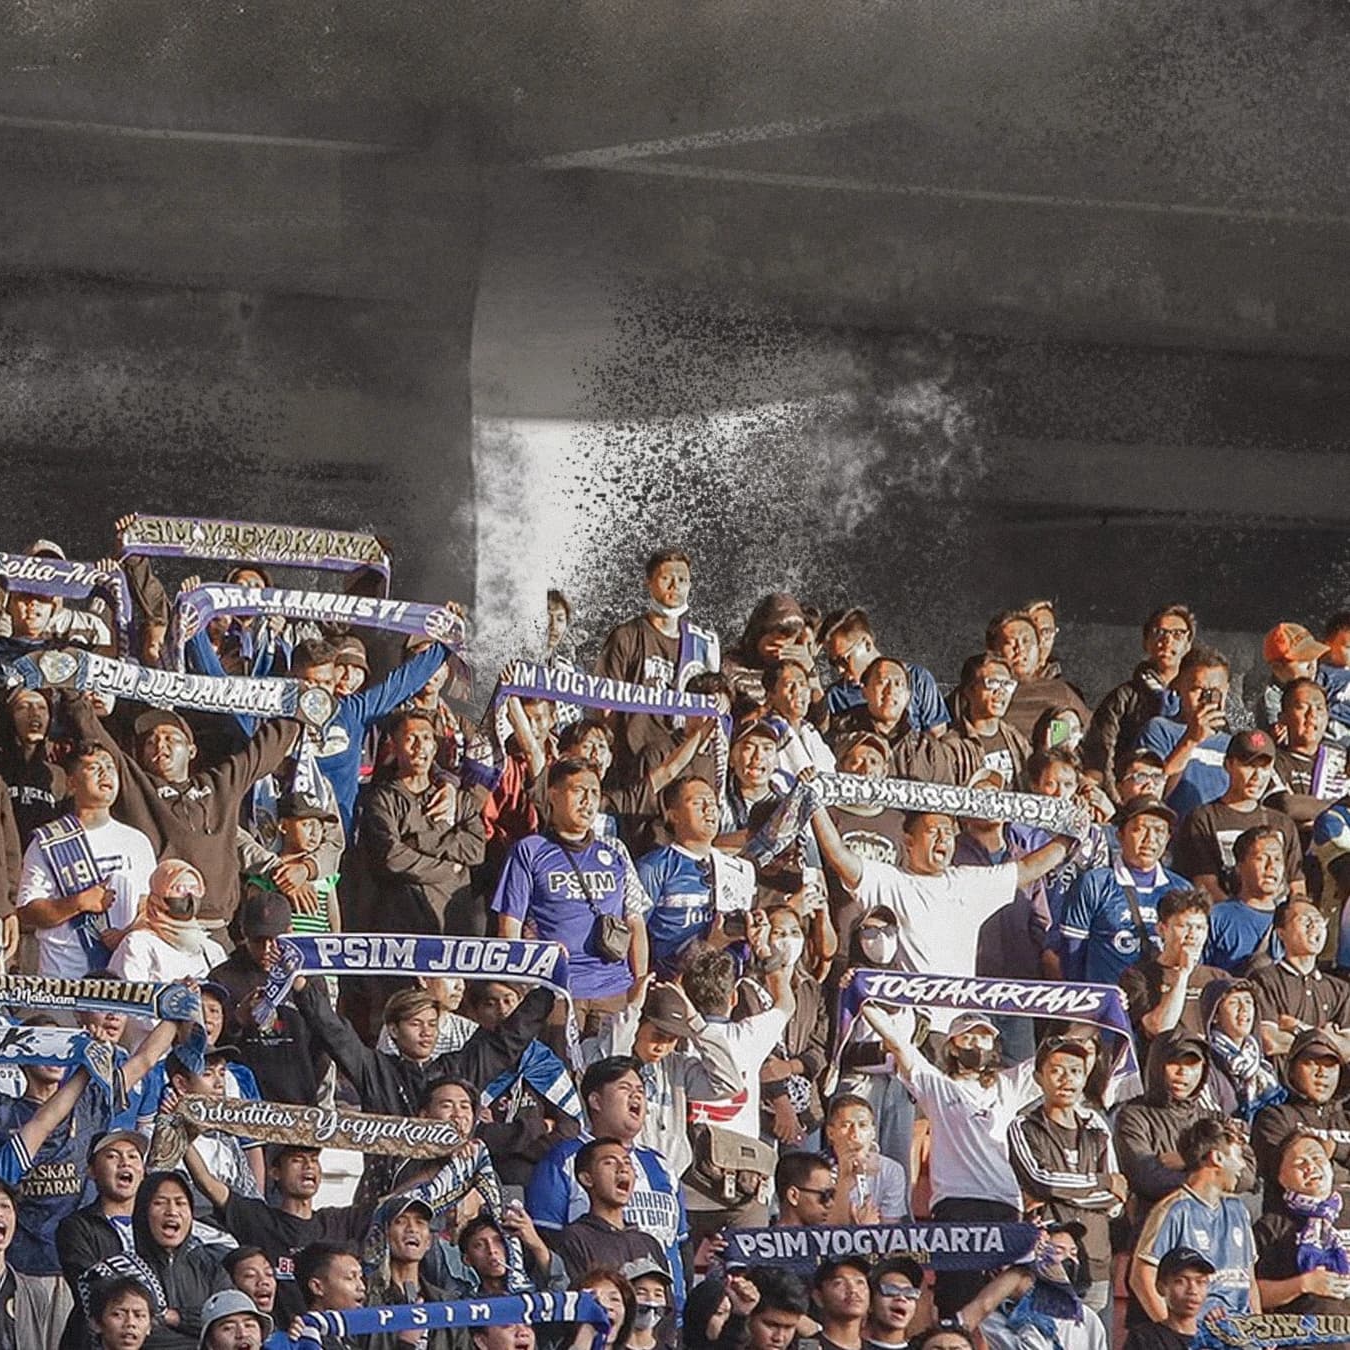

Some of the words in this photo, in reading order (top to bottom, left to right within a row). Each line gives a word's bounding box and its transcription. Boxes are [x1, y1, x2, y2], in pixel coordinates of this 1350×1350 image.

[127, 518, 194, 543] PSIM
[201, 522, 385, 562] YOGYAKARTA
[86, 656, 135, 693] PSIM
[137, 670, 283, 715] JOGJAKARTA
[60, 858, 93, 888] 19
[548, 869, 616, 893] PSIM
[313, 937, 417, 969] PSIM
[428, 940, 561, 978] JOGJA
[11, 986, 76, 1005] Mataram
[190, 1101, 297, 1127] Identitas
[304, 1107, 462, 1145] Yogyakarta
[27, 1162, 77, 1179] ASKAR
[735, 1230, 809, 1259] PSIM
[812, 1226, 1005, 1254] YOGYAKARTA
